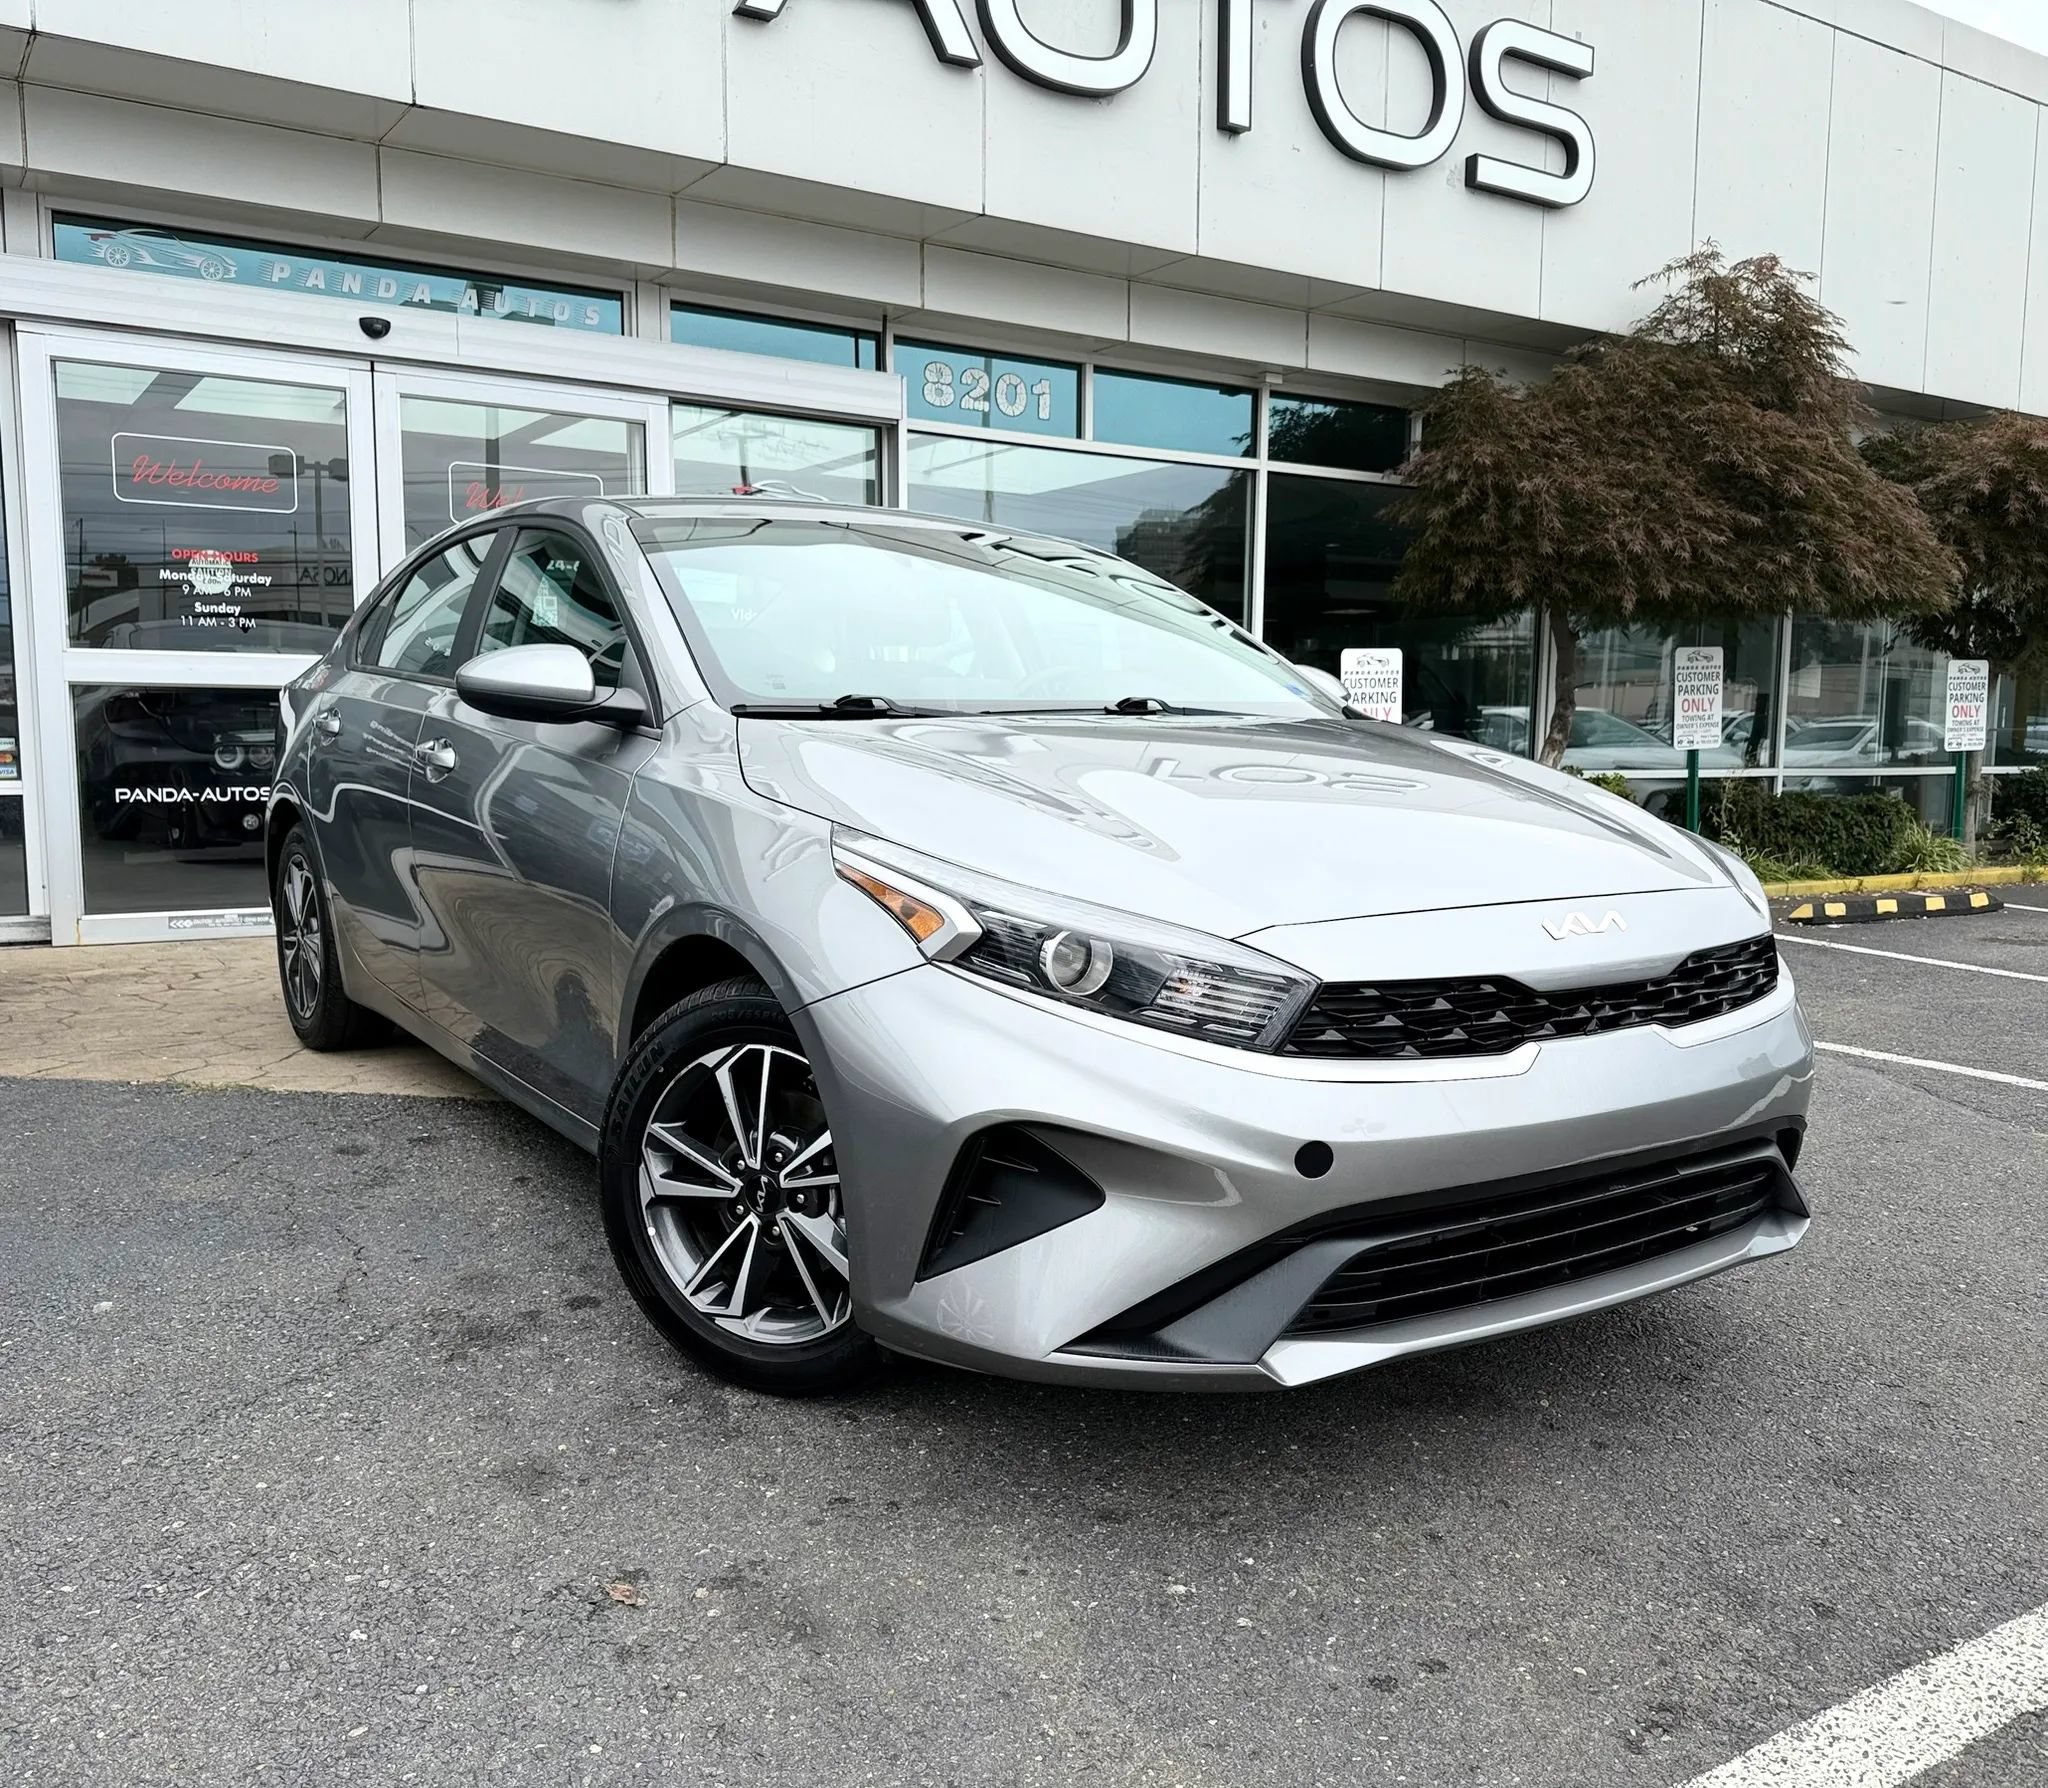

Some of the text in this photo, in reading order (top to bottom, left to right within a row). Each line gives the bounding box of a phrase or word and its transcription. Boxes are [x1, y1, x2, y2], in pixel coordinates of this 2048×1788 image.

[733, 0, 1597, 208] UTOS
[270, 262, 600, 326] PANDA AUTOS
[922, 361, 1050, 421] 8201
[132, 454, 280, 493] Welcome
[171, 548, 259, 563] OPEN HOURS
[182, 584, 252, 597] 9 AM 6 PM
[194, 602, 241, 617] Sunday
[181, 616, 193, 626] 11
[198, 616, 217, 627] AM
[228, 617, 236, 628] 3
[239, 618, 257, 629] PM
[1343, 677, 1399, 689] CUSTOMER
[1676, 671, 1720, 682] CUSTOMER
[1678, 684, 1719, 696] PARKING
[1948, 681, 1986, 691] CUSTOMER
[1351, 691, 1397, 704] ARKING
[1949, 692, 1985, 703] PARKING
[1681, 697, 1715, 713] ONLY
[1952, 704, 1981, 718] ONLY
[1363, 707, 1392, 720] NLY
[1681, 714, 1706, 722] TOWING
